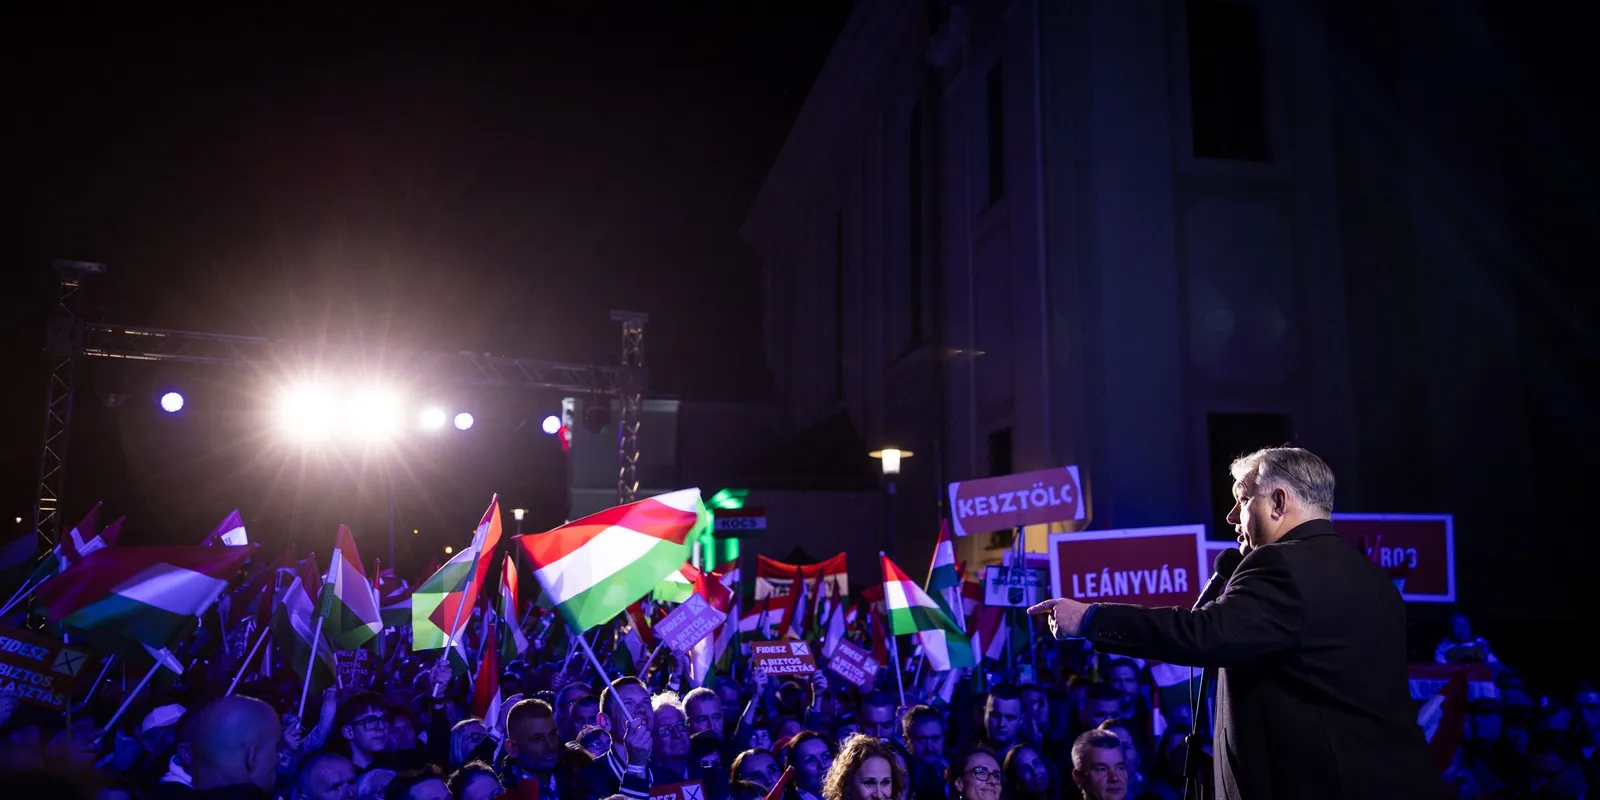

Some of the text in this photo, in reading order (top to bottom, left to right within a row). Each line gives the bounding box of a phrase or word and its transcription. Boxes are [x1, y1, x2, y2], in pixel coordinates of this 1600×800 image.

[958, 482, 1073, 519] KESZTÖLC
[721, 519, 757, 529] KOCS
[1072, 564, 1188, 598] LEÁNYVÁR
[660, 611, 687, 636] FIDESZ
[676, 616, 706, 641] BIZTOS
[756, 645, 787, 654] FIDESZ
[763, 663, 815, 673] VÁLASZTÁS
[767, 657, 802, 666] BIZTOS
